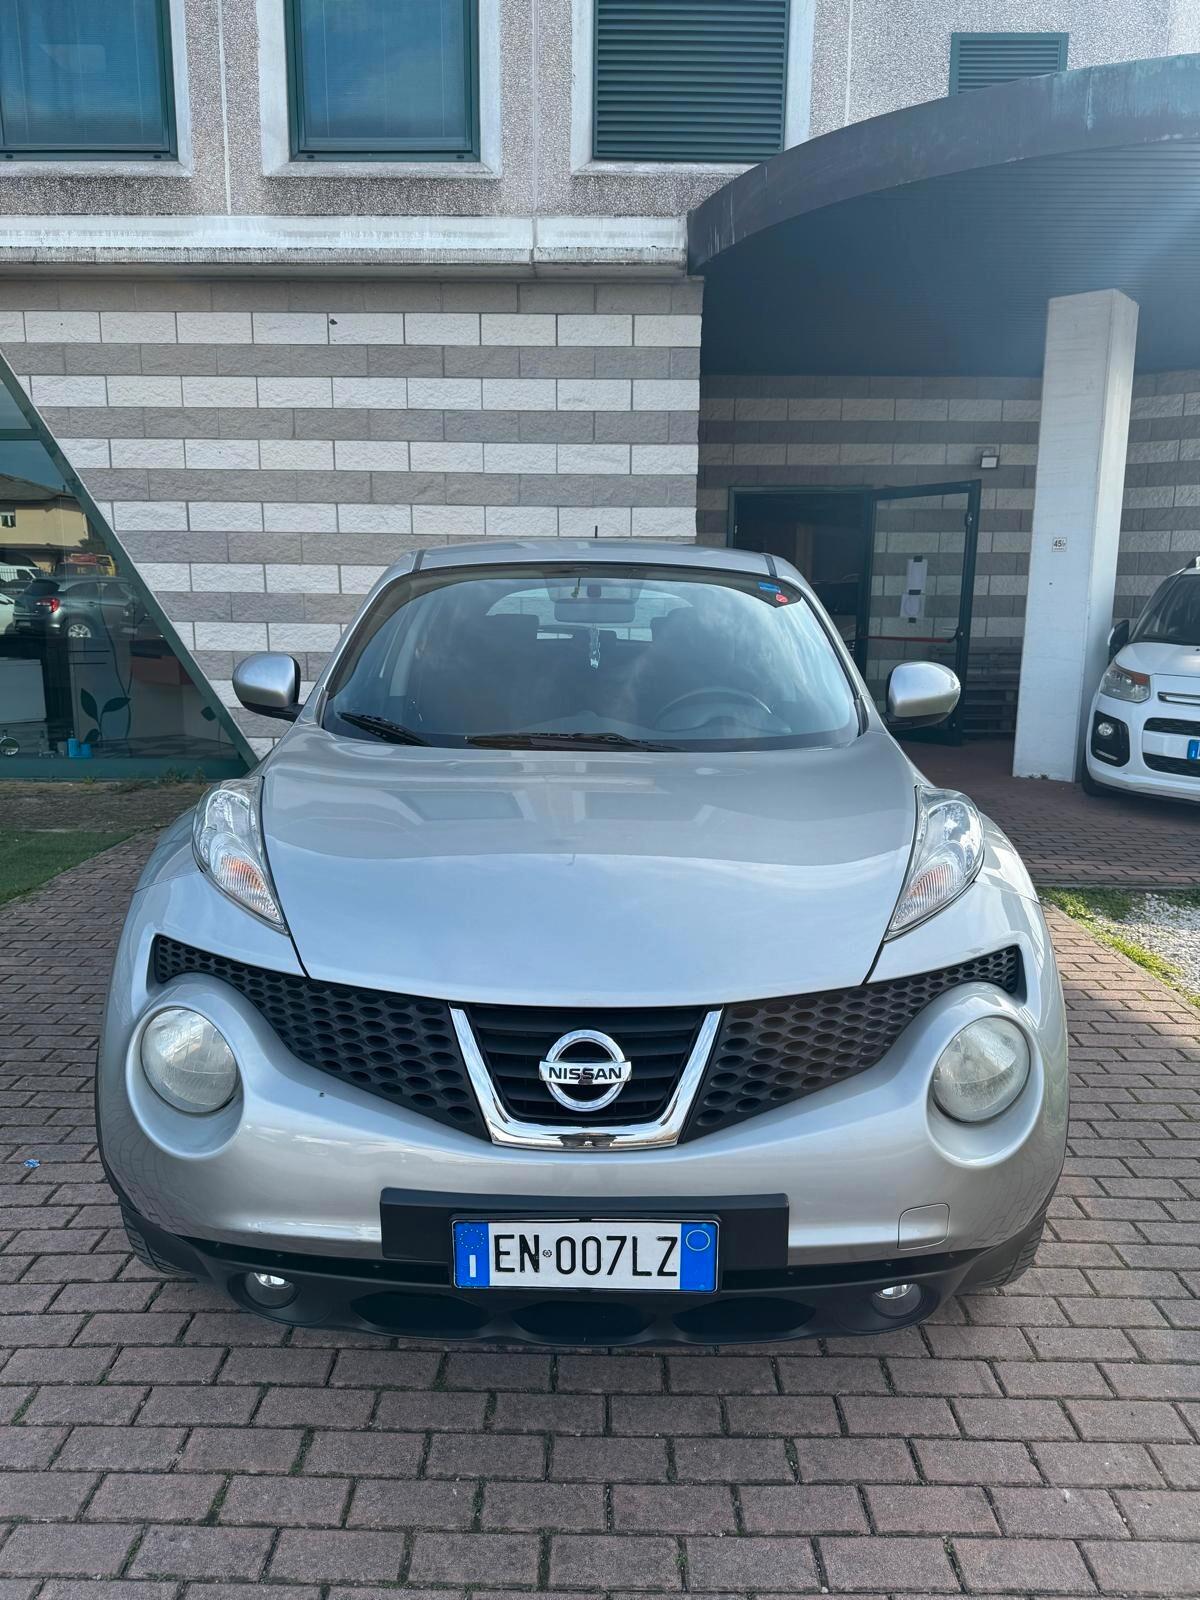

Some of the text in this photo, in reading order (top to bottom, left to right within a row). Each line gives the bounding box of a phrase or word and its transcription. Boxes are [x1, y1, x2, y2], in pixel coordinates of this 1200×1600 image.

[548, 1066, 622, 1081] NISSAN
[469, 1254, 477, 1278] I
[493, 1234, 678, 1277] EN 007LZ
